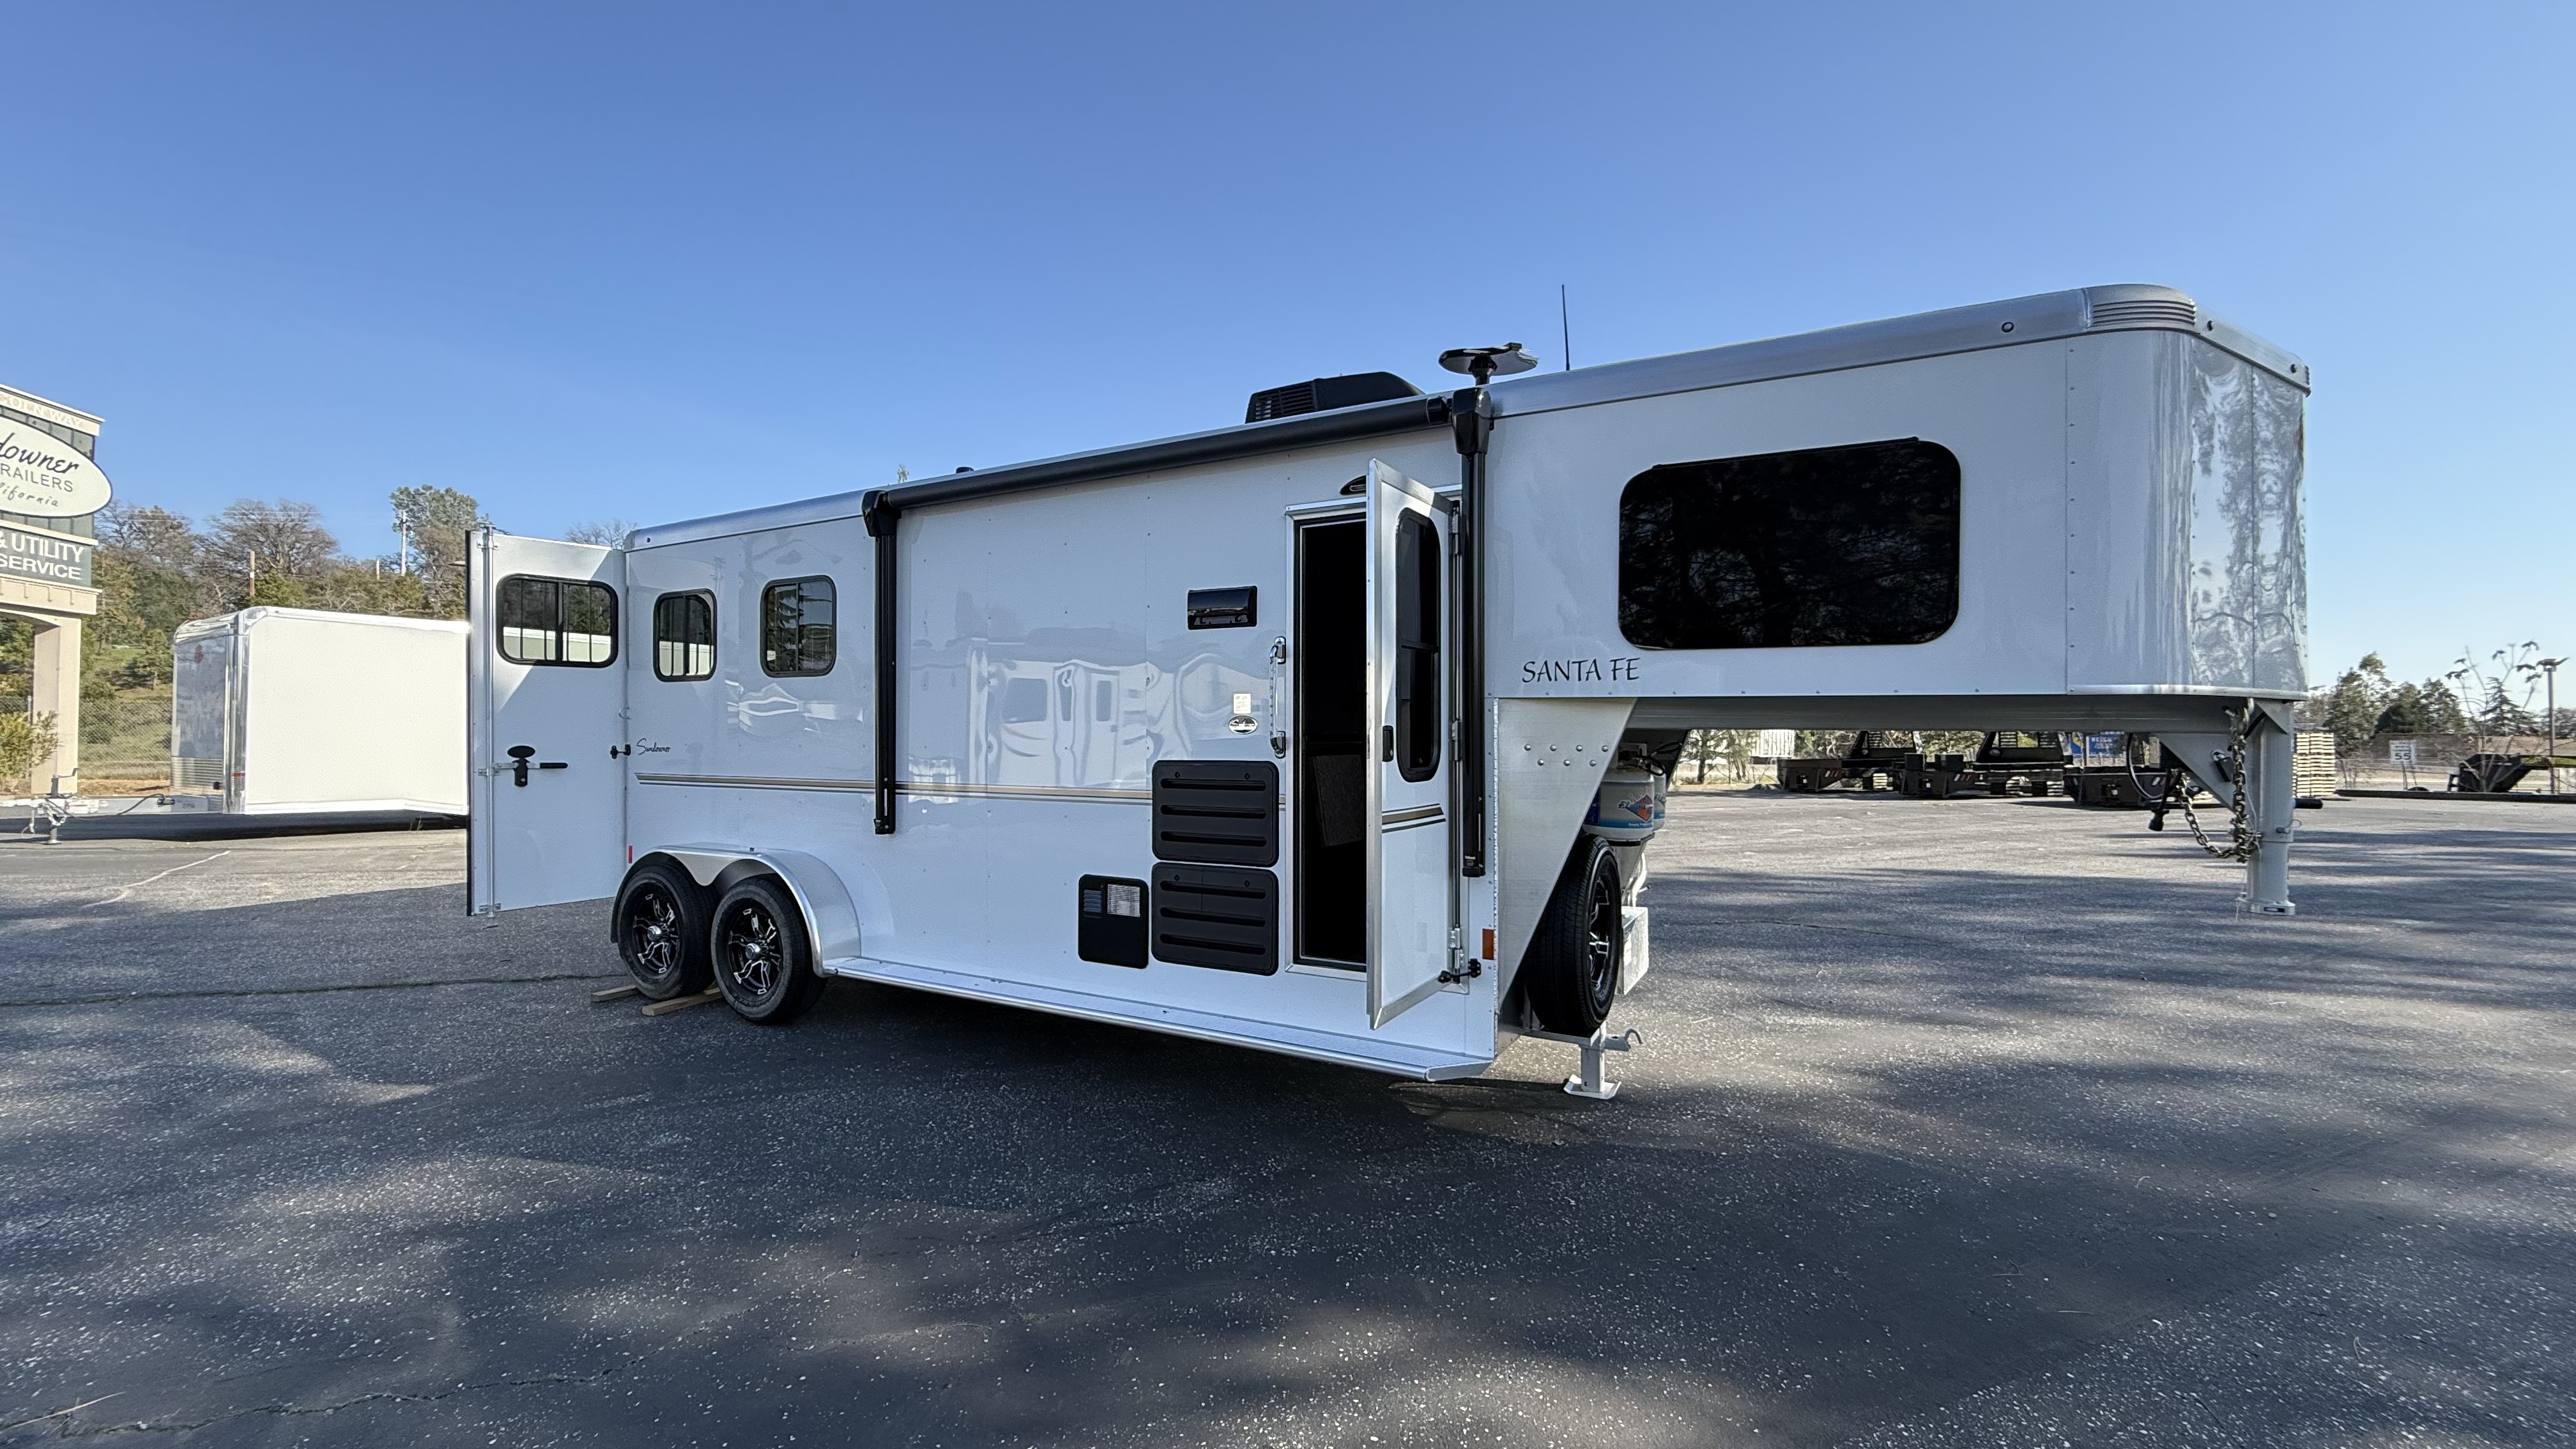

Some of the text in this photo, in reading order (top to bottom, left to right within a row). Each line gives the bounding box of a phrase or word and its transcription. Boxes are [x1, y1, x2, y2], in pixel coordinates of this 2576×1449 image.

[0, 463, 73, 493] RAILERS
[12, 532, 85, 562] UTILITY
[0, 553, 82, 580] SERVICE
[1522, 657, 1641, 683] SANTA FE
[2395, 752, 2411, 760] 55
